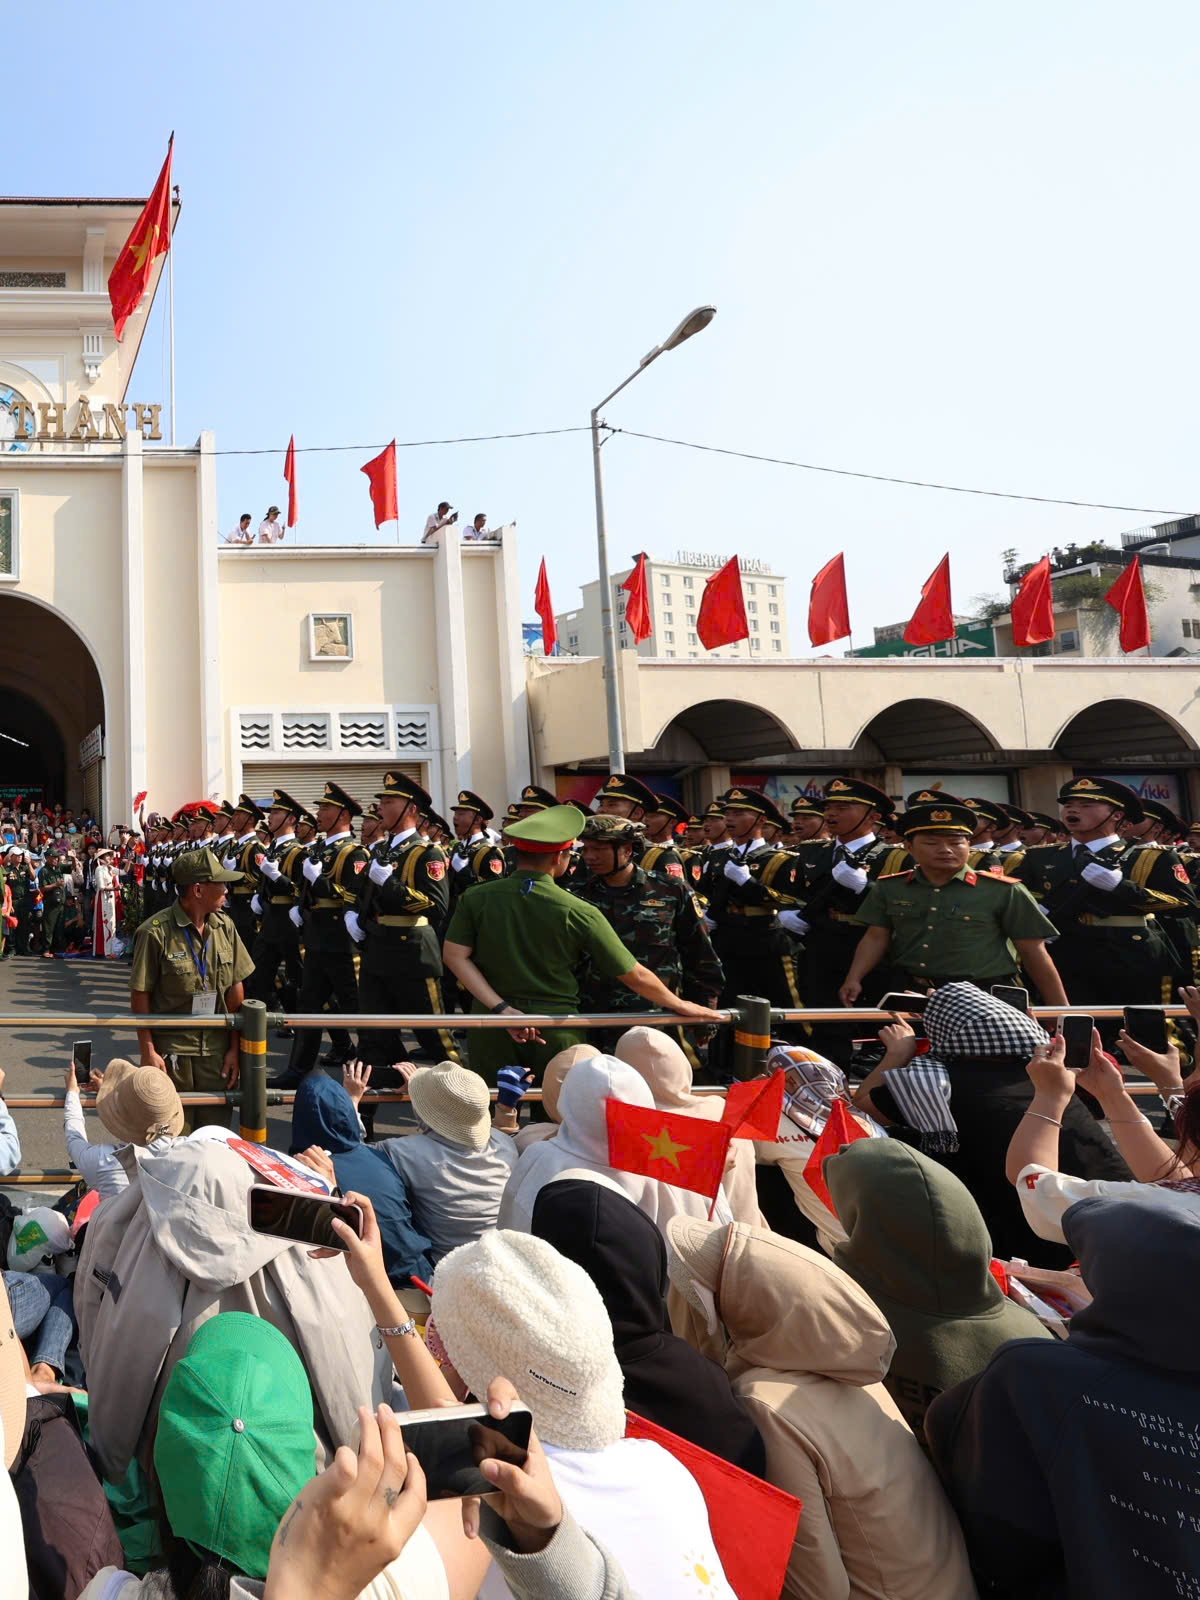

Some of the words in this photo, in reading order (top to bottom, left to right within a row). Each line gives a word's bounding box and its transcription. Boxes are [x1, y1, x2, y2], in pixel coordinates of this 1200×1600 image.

[8, 395, 162, 440] THÀNH
[1129, 778, 1170, 799] Vikki
[1082, 1394, 1184, 1429] Unstoppable
[1110, 1494, 1167, 1524] Radiant
